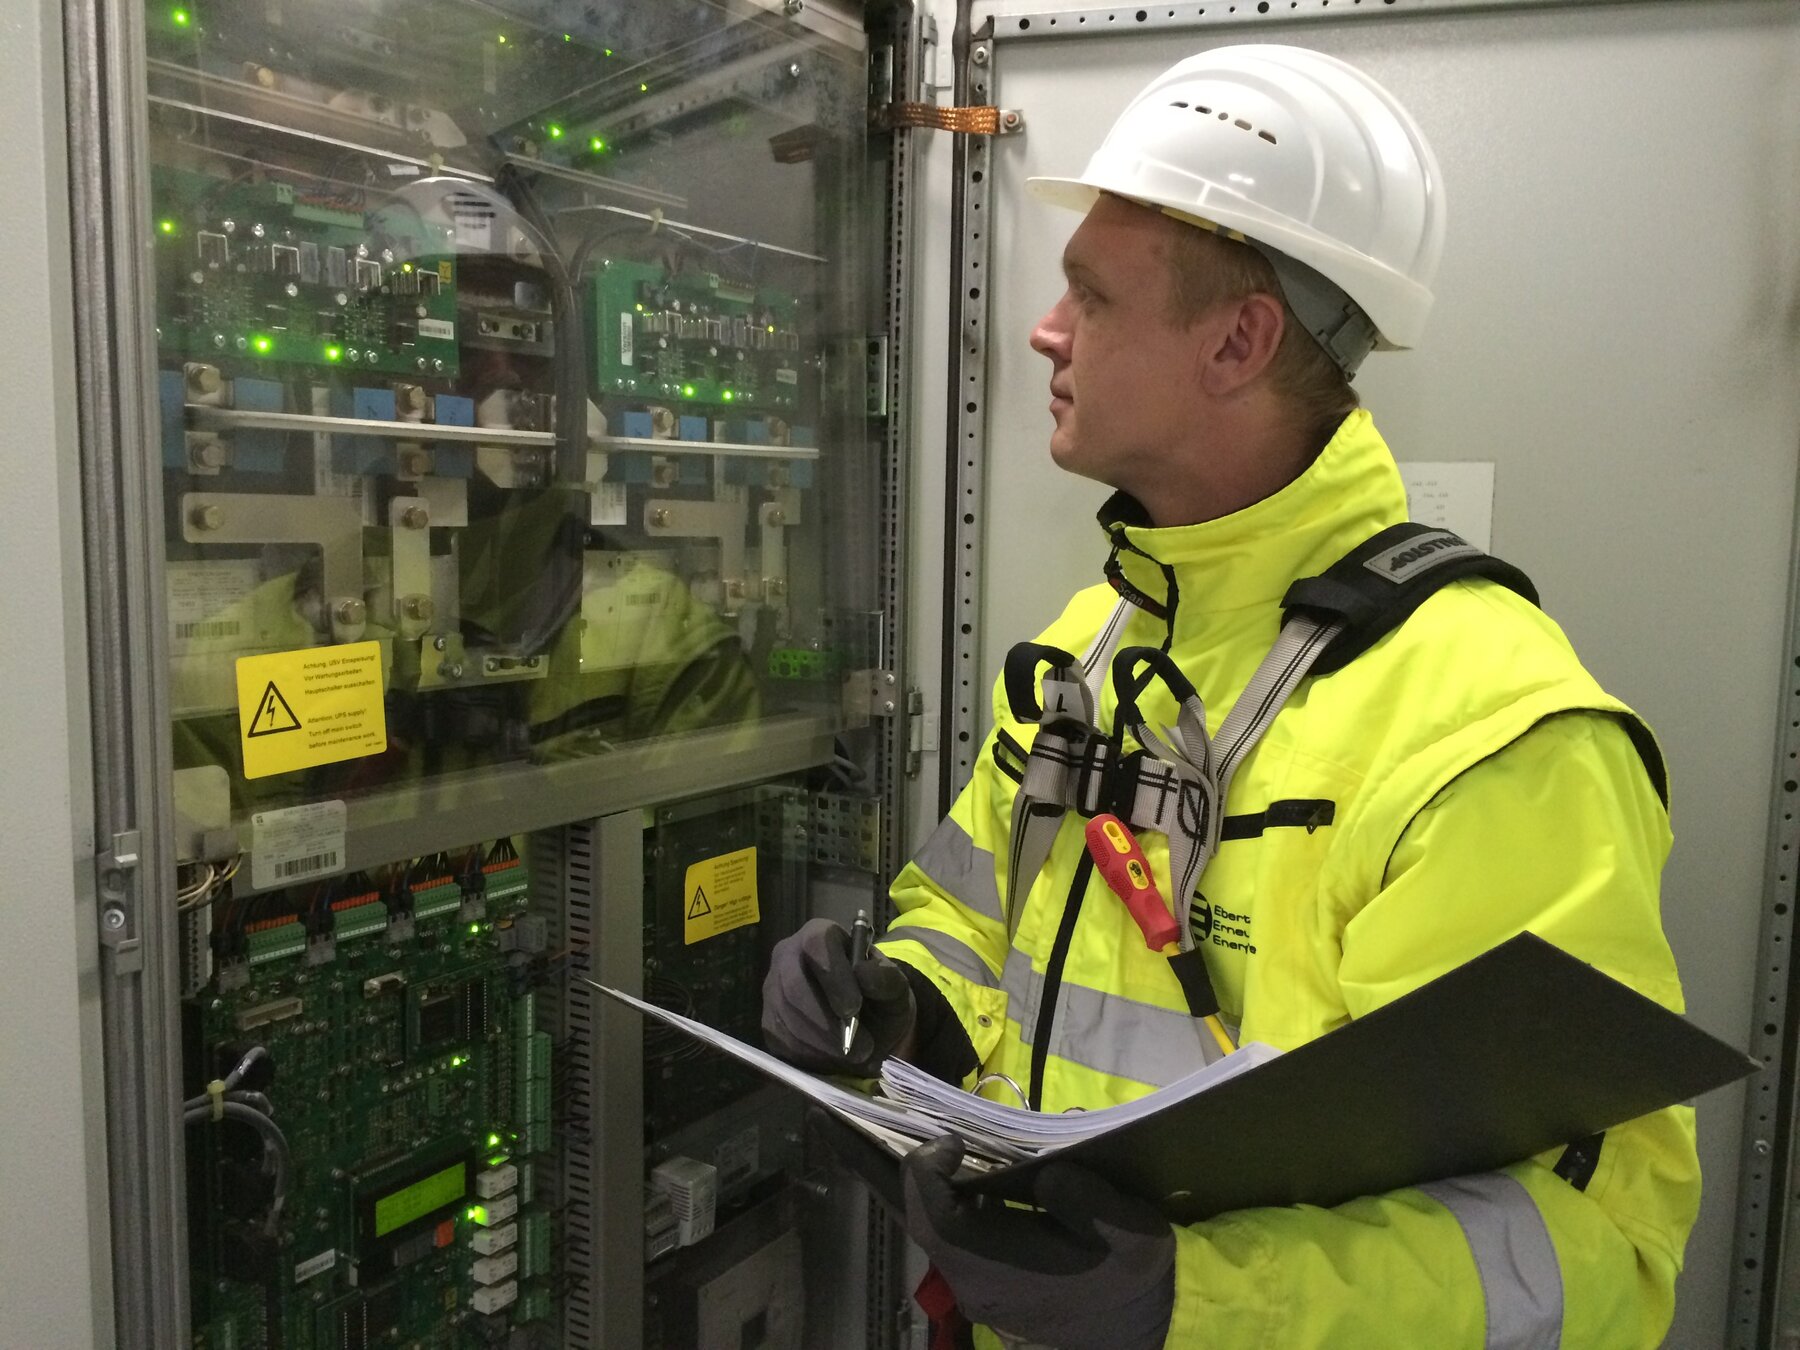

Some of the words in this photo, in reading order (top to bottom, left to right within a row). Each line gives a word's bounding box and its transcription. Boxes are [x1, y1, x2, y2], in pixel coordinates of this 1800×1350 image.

[1118, 582, 1144, 606] Scan
[1056, 693, 1068, 712] L
[334, 712, 347, 720] UPS
[328, 736, 362, 745] maintenance
[1214, 905, 1251, 924] Ebert
